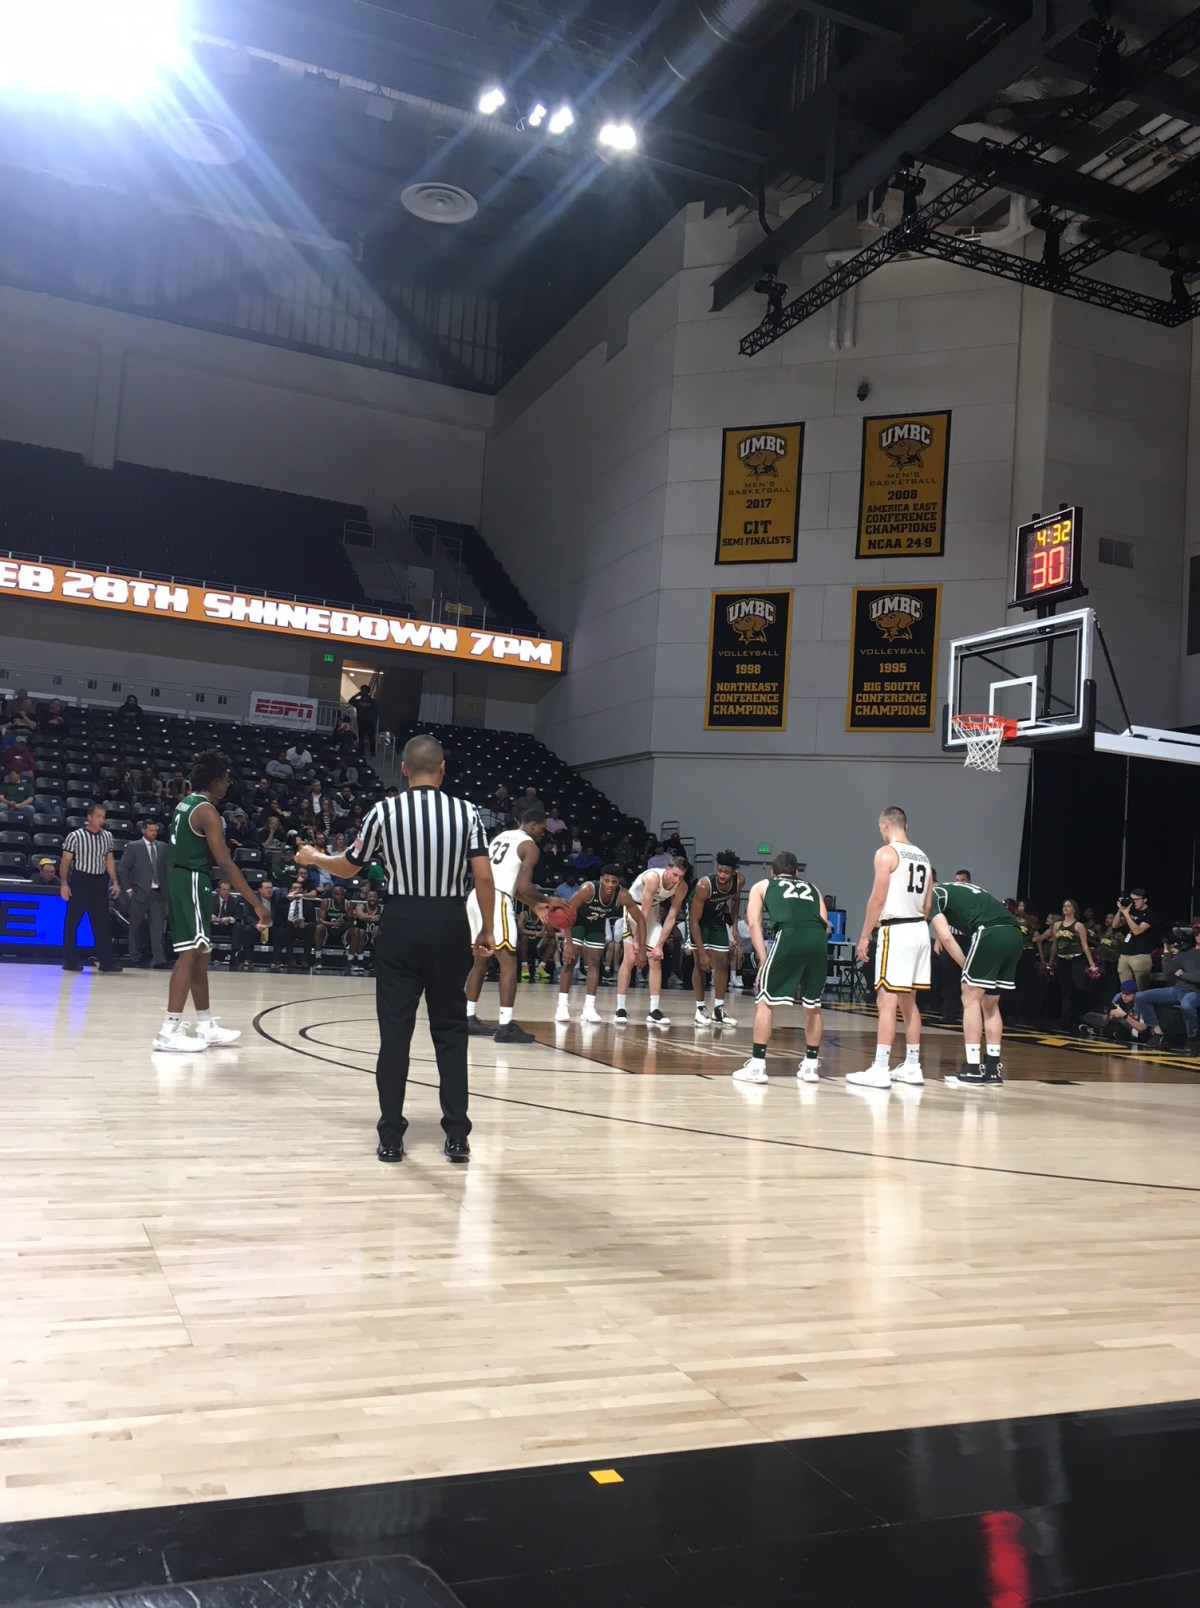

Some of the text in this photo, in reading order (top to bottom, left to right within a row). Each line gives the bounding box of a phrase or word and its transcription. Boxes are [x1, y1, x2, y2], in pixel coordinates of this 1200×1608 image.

[880, 423, 931, 448] UMBC
[739, 435, 786, 458] UMBC
[887, 471, 920, 479] MEN'S
[744, 480, 775, 489] MEN'S
[869, 478, 937, 487] BASKETBALL
[728, 486, 791, 496] BASKETBALL
[887, 489, 918, 500] 2008
[745, 498, 772, 509] 2017
[867, 502, 938, 513] AMERICA EAST
[866, 511, 937, 524] CONFERENCE
[743, 519, 772, 535] CIT
[865, 522, 937, 535] CHAMPIONS
[1036, 519, 1072, 547] 4:32
[867, 537, 933, 550] NCAA 24-9
[1032, 545, 1065, 590] 30
[728, 600, 775, 622] UMBC
[871, 596, 921, 620] UMBC
[62, 570, 190, 614] 28TH
[203, 591, 458, 652] SHINEDOWN
[469, 631, 553, 666] 7PM
[735, 664, 761, 675] 1998
[879, 662, 907, 674] 1995
[716, 682, 778, 692] NORTHEAST
[863, 681, 920, 692] BIG SOUTH
[713, 693, 779, 703] CONFERENCE
[855, 693, 927, 703] CONFERENCE
[254, 698, 314, 719] ESPN
[713, 705, 779, 715] CHAMPIONS
[855, 705, 926, 716] CHAMPIONS
[907, 862, 927, 894] 13
[778, 880, 814, 902] 22
